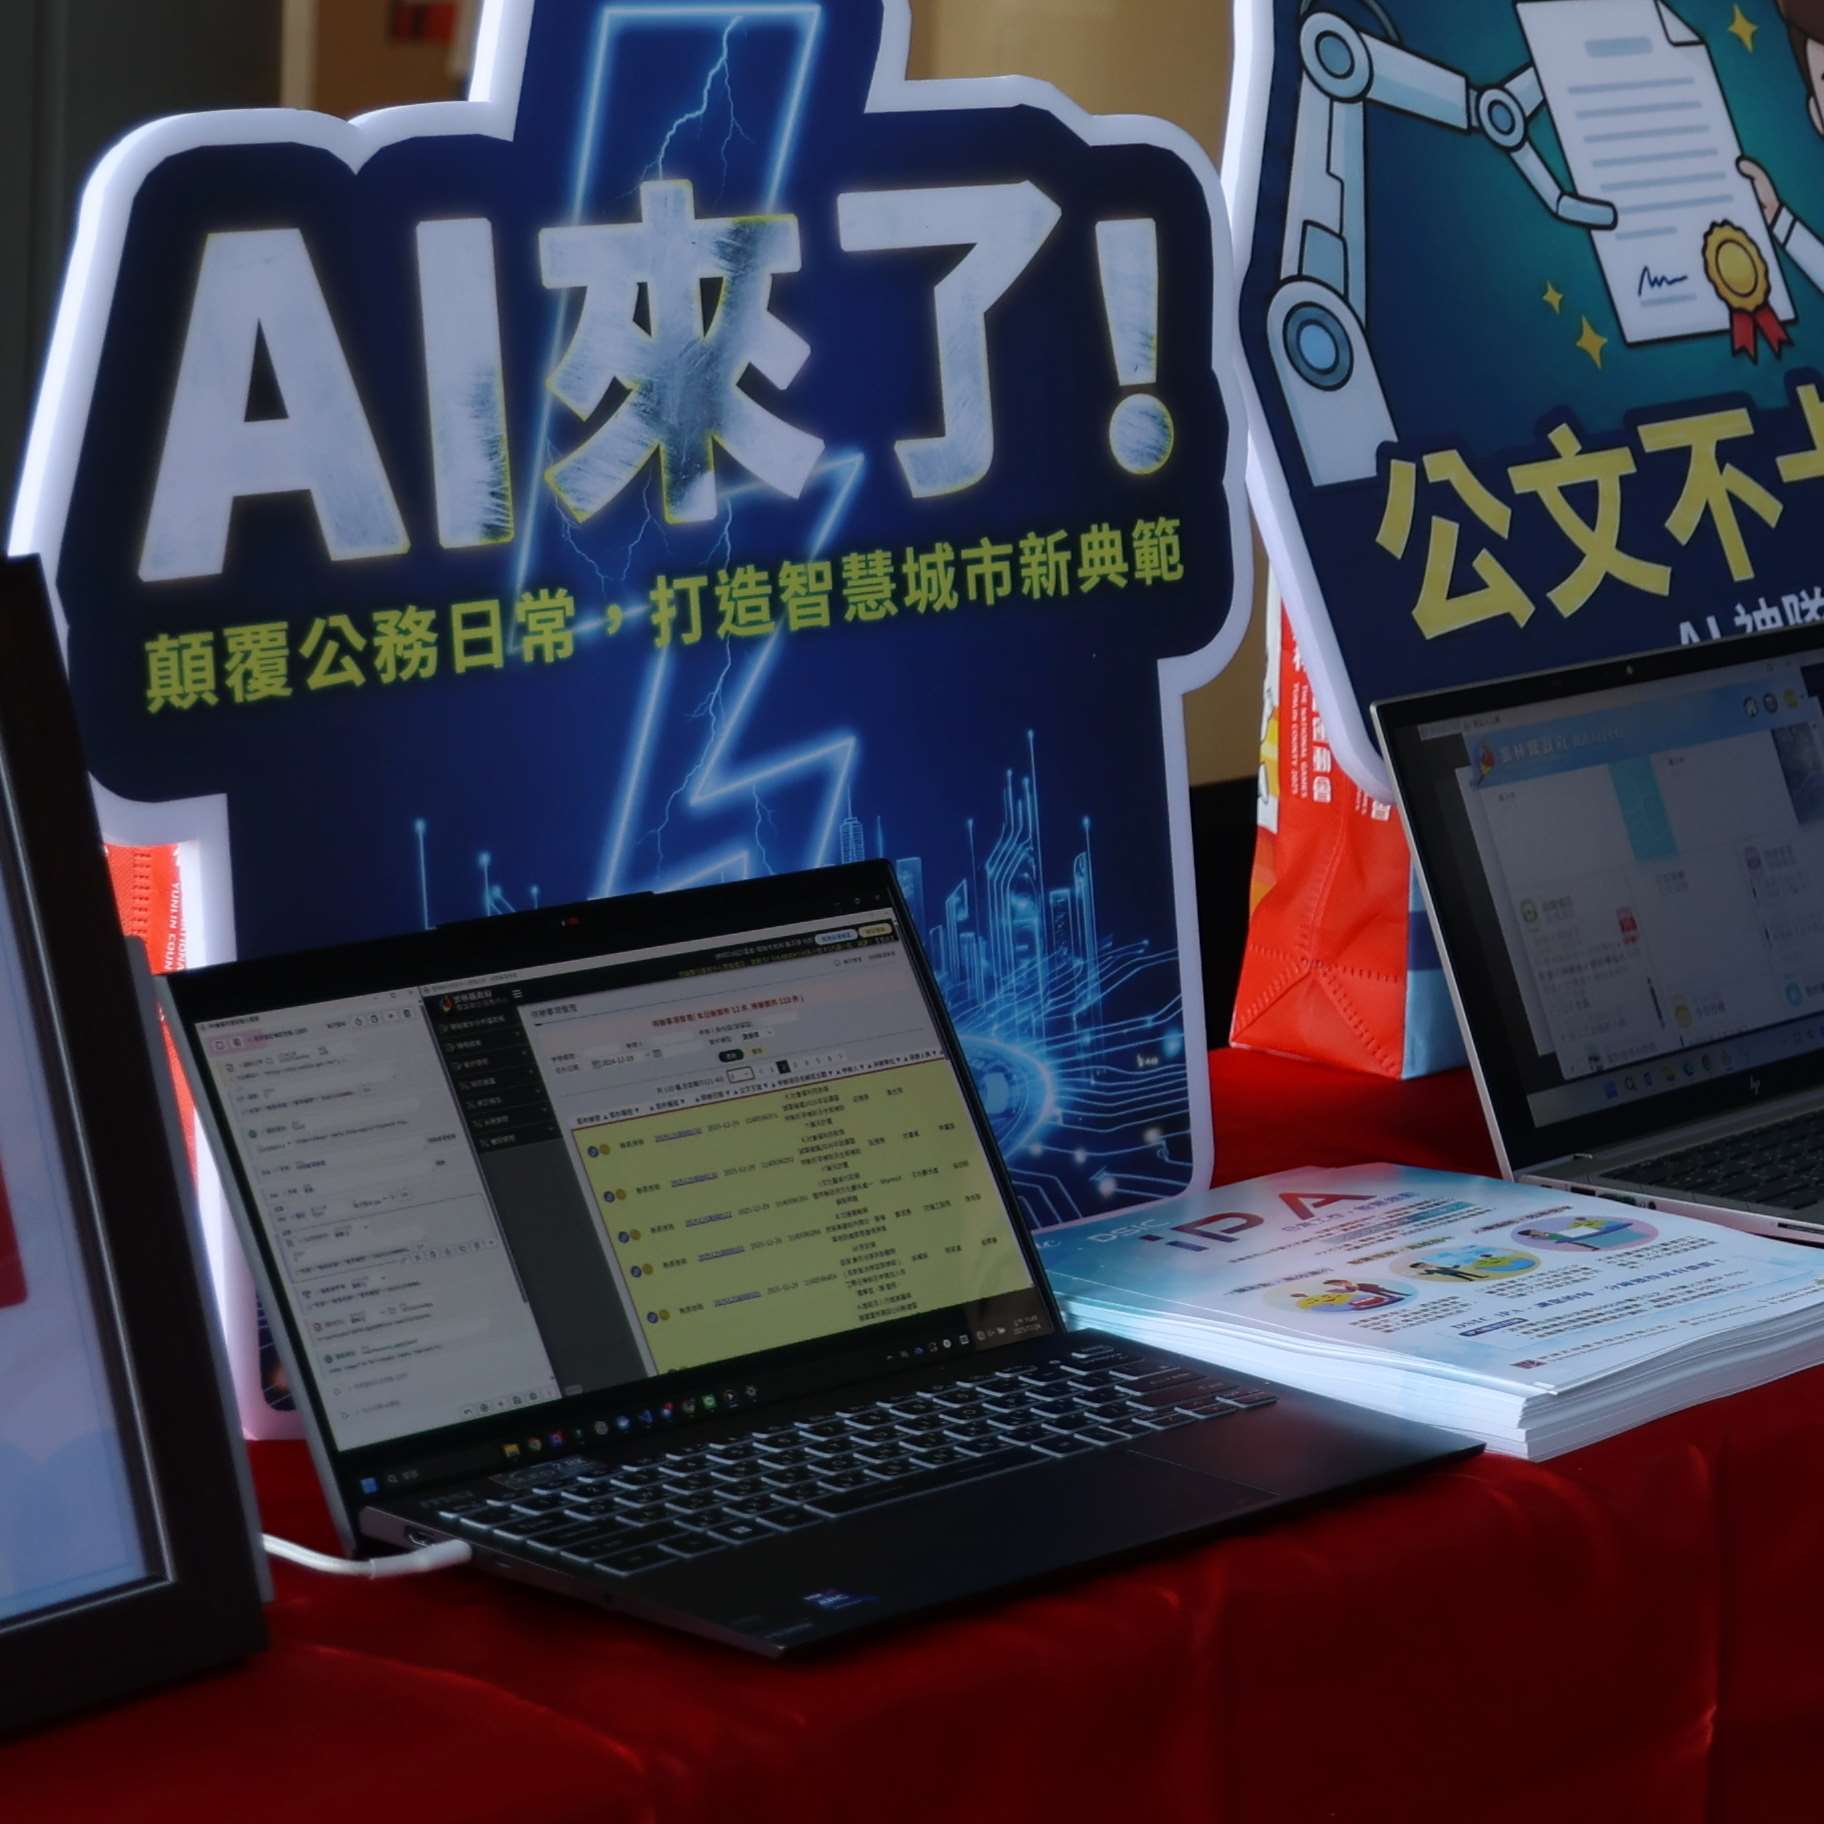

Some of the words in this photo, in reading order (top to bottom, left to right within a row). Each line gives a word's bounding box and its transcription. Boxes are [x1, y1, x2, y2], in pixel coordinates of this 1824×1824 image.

[145, 517, 1186, 715] 顛覆公務日常，打造智慧城市新典範
[169, 882, 181, 929] YUNLIN
[163, 933, 177, 971] COUN
[1139, 1191, 1377, 1253] iPA
